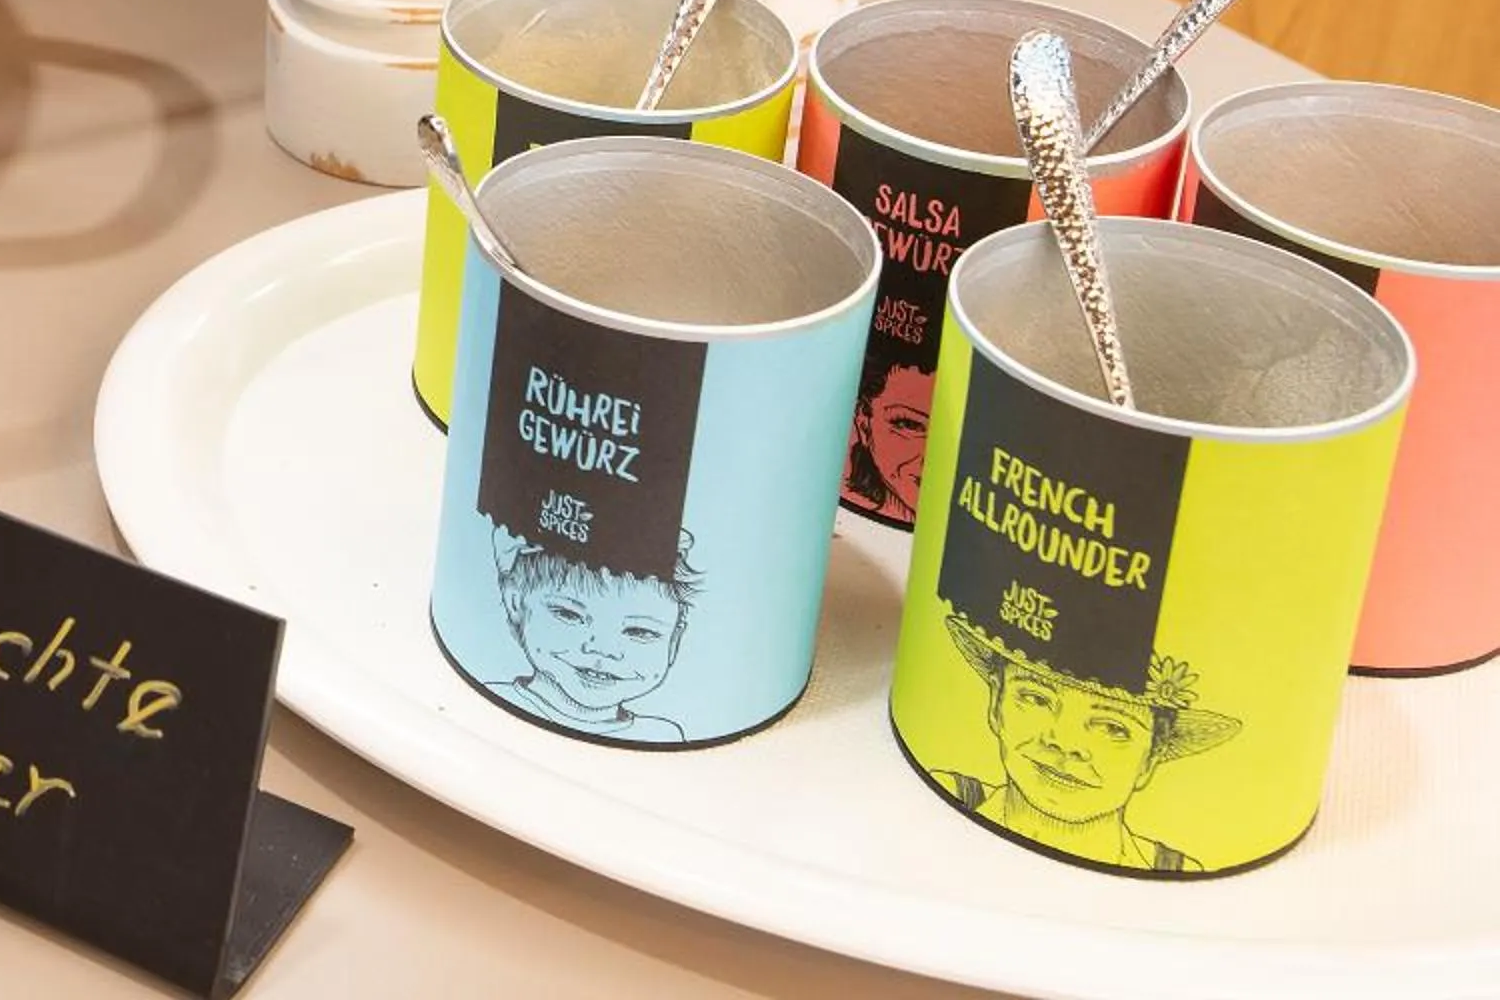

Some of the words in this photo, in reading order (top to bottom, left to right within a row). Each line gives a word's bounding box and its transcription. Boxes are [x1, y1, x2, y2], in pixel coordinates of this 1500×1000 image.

[875, 183, 962, 239] SALSA
[864, 216, 966, 277] WÜR
[877, 295, 921, 323] JUST
[518, 408, 641, 484] GEWÜRZ
[541, 489, 586, 520] JUST
[990, 446, 1116, 540] FRENCH
[957, 476, 1152, 590] ALLROUNDER
[1003, 580, 1053, 615] JUST
